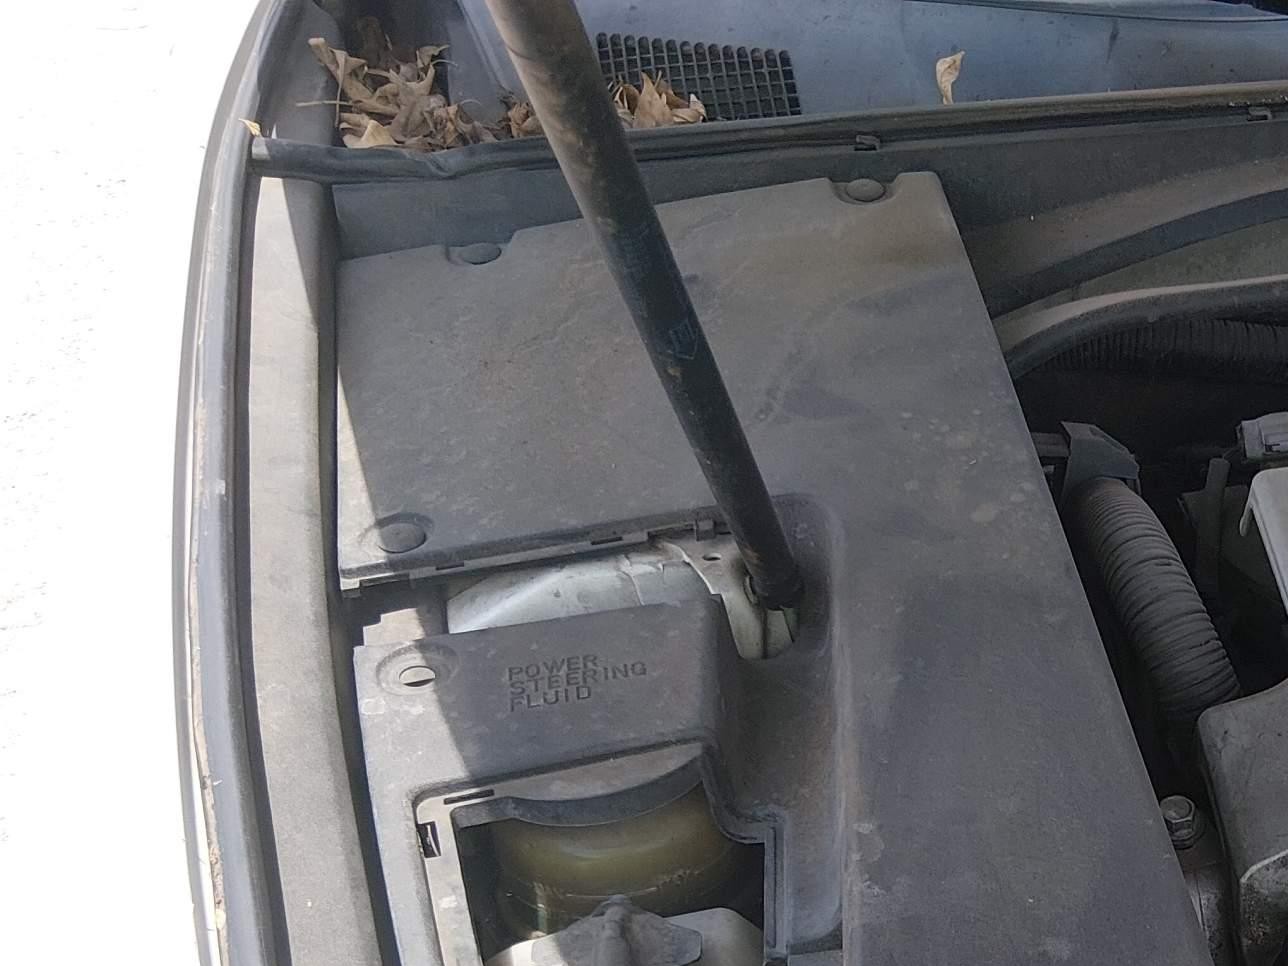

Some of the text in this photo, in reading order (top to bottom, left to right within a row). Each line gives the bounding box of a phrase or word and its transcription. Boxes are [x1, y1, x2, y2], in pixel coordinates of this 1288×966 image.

[508, 654, 598, 681] POWER
[509, 661, 647, 695] STEERING
[508, 686, 593, 713] FLUID
